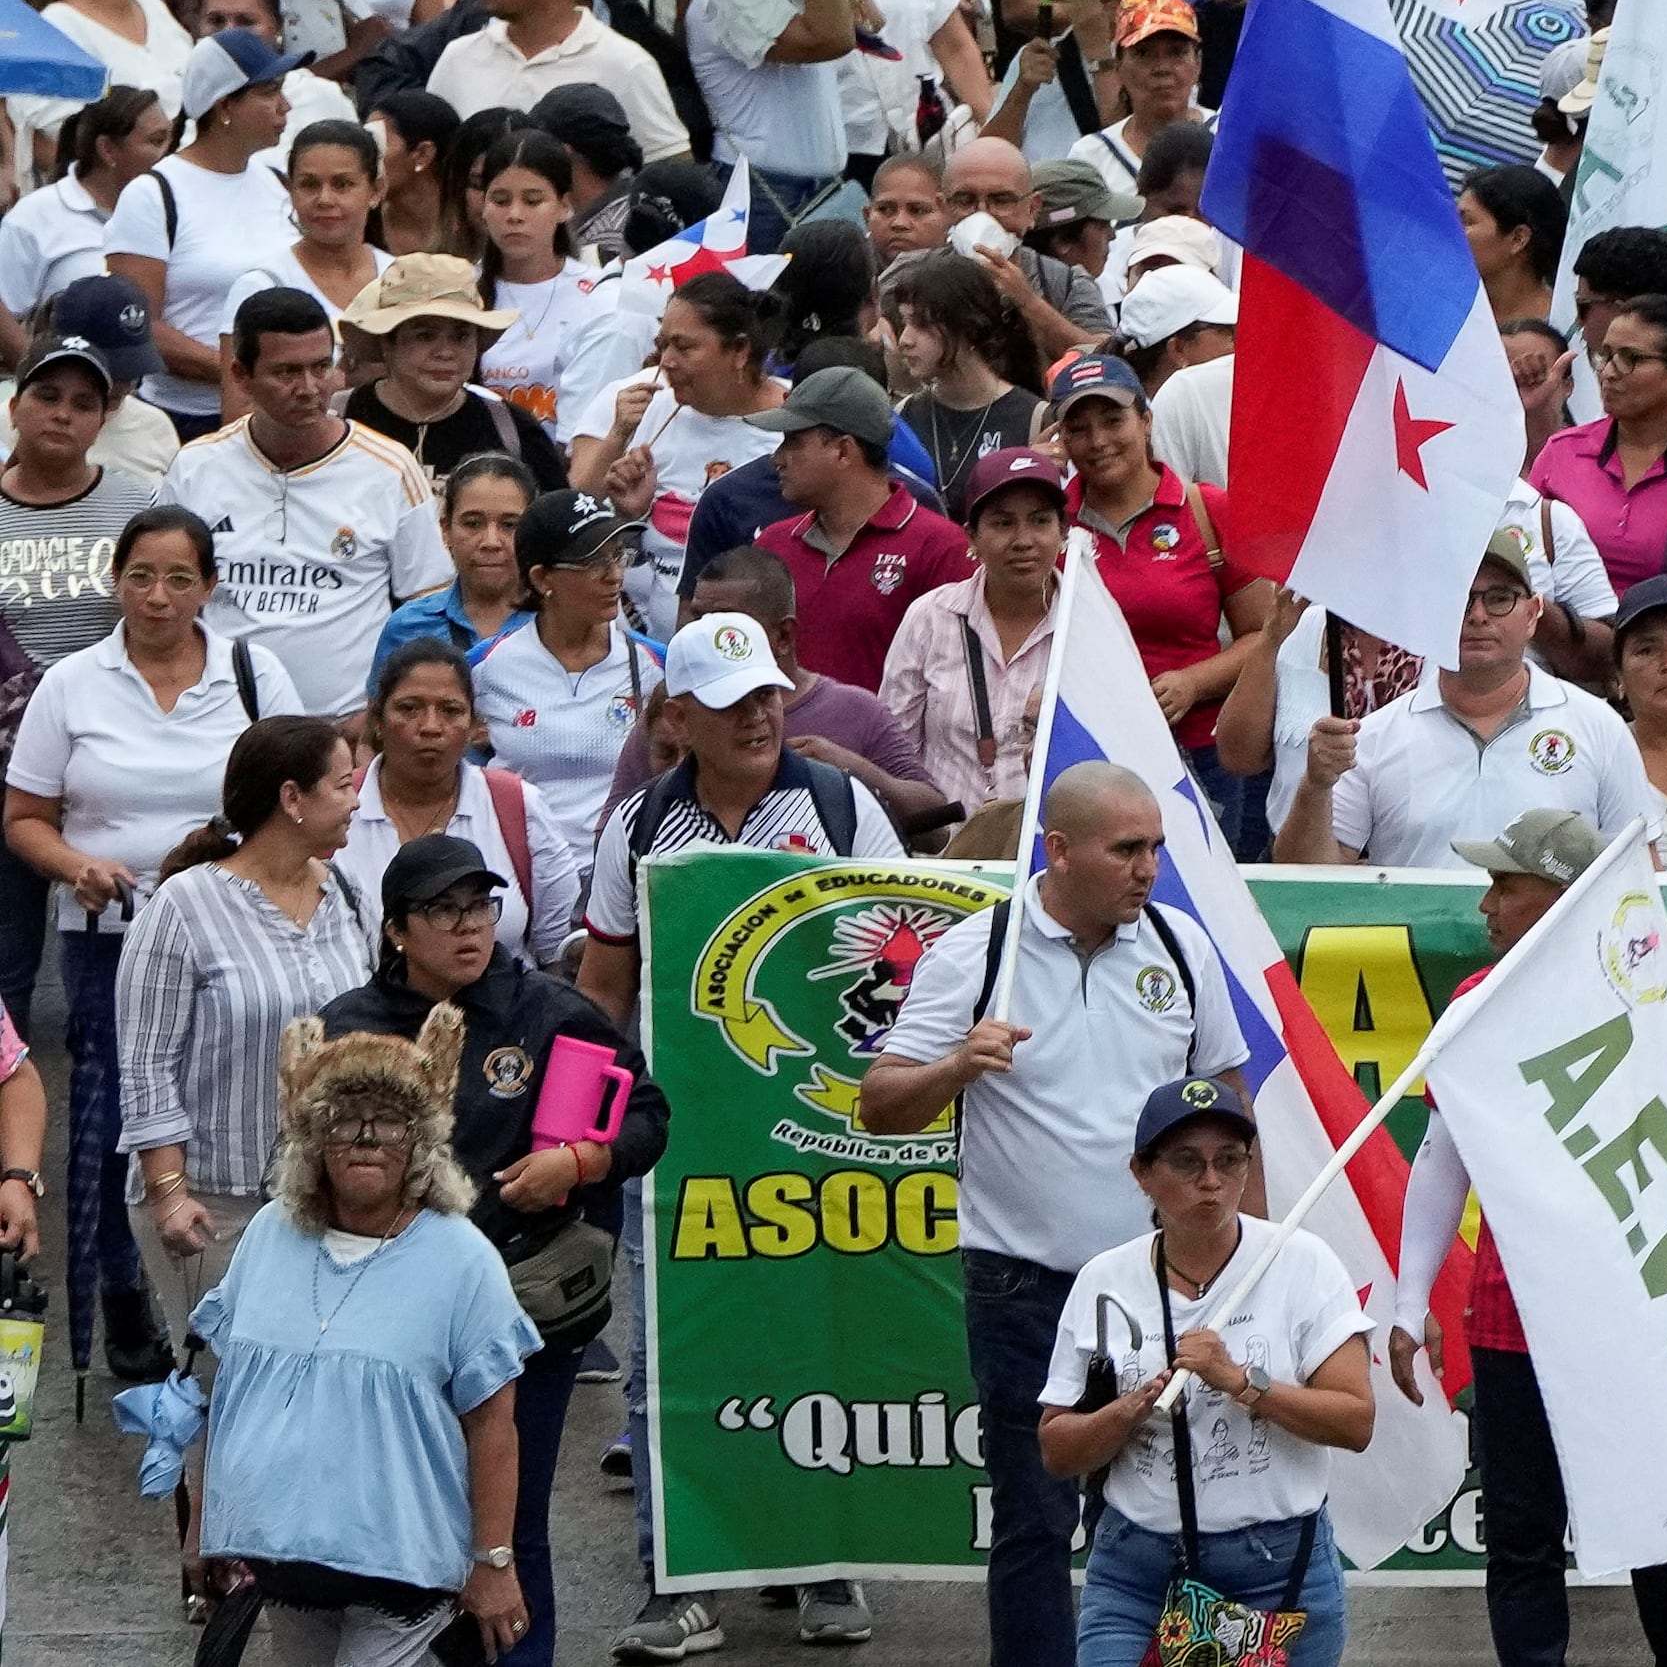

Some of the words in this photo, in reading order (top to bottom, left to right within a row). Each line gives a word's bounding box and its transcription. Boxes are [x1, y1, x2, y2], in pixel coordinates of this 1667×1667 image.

[214, 556, 343, 589] Emirates
[257, 590, 320, 613] BETTER
[708, 903, 779, 1009] ASOCIACION
[815, 871, 989, 903] EDUCADORES
[774, 1122, 892, 1161] República
[899, 1143, 928, 1161] de
